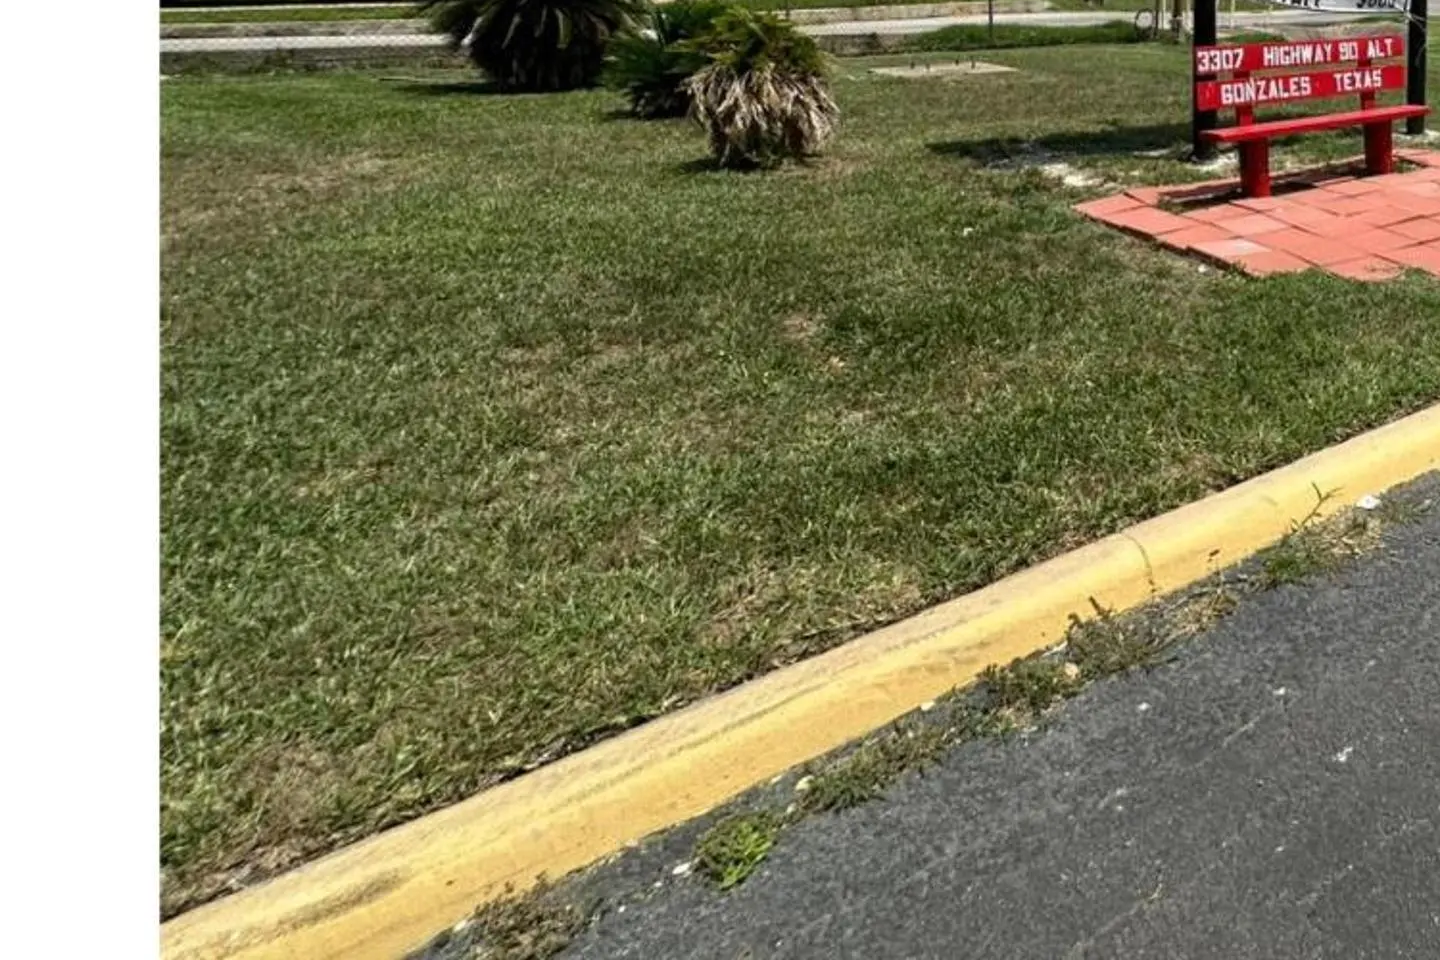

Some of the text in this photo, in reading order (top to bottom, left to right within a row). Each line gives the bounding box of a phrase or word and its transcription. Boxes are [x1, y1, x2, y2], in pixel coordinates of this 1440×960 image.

[1196, 38, 1393, 72] 3307 HIGHWAY 90 ALT
[1220, 69, 1382, 104] GONZALES TEXAS
